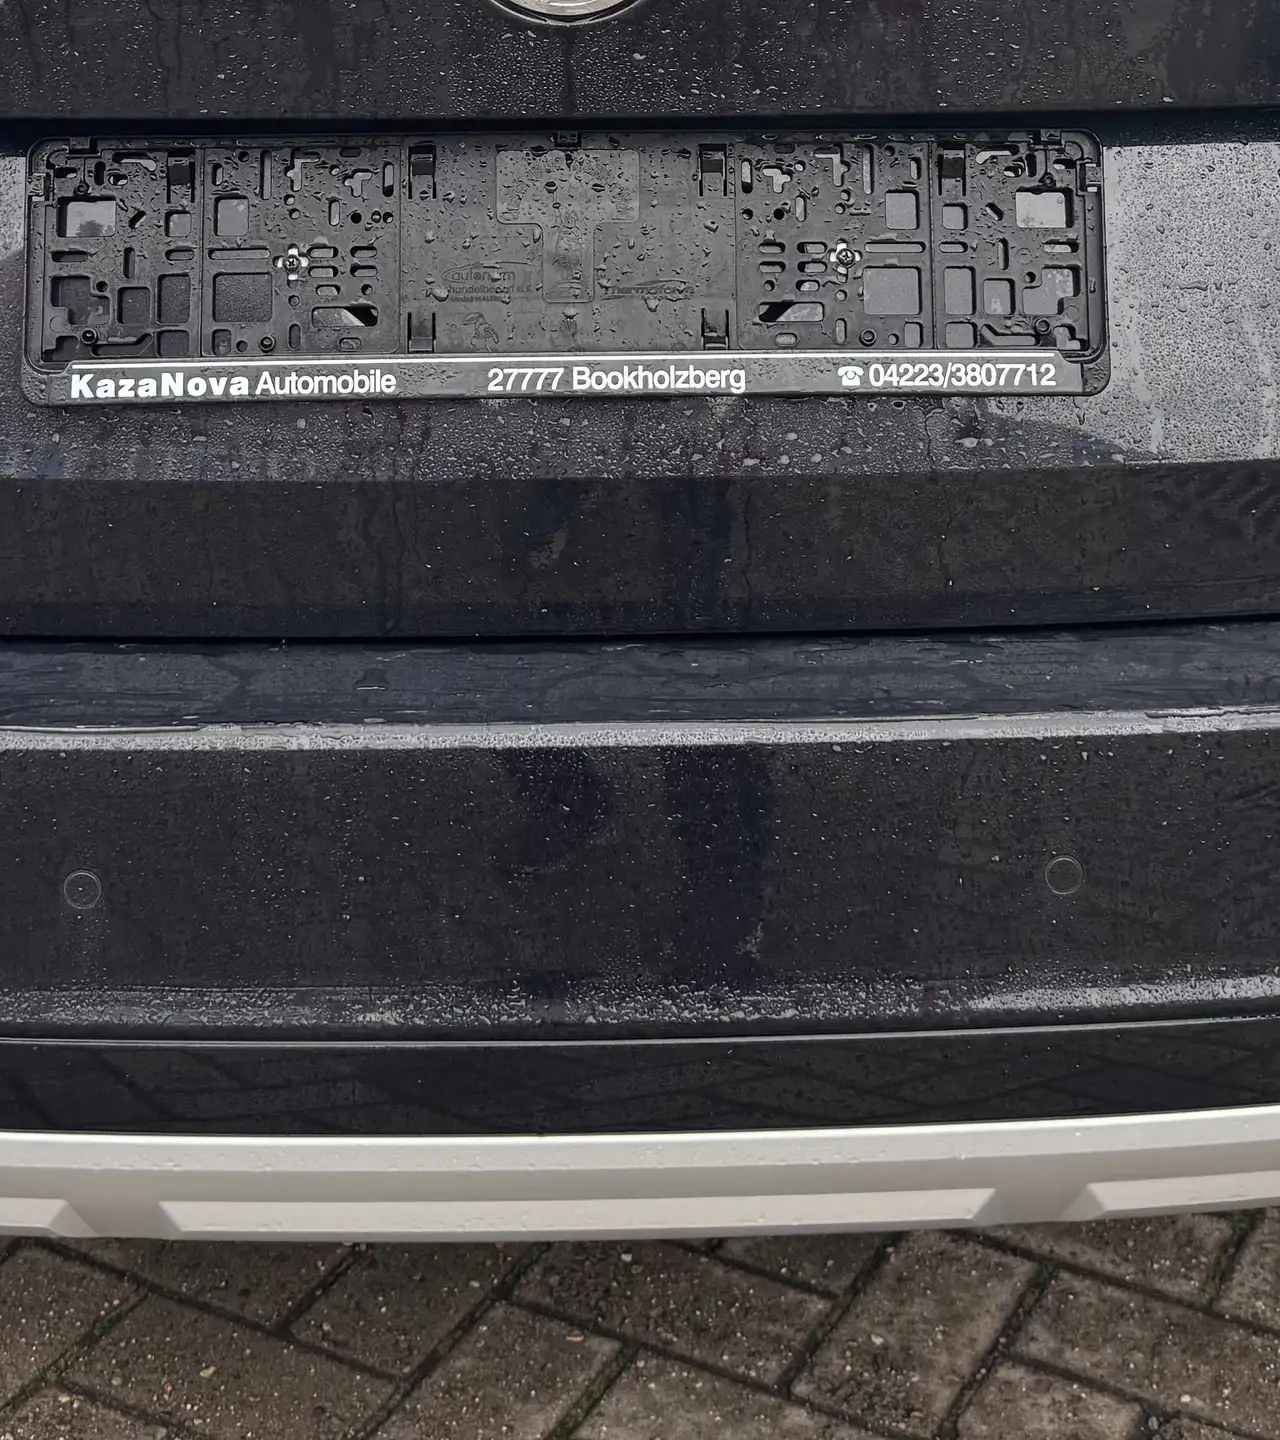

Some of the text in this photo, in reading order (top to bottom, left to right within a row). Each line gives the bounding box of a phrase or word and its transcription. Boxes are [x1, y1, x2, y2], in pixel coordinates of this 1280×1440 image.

[70, 361, 1057, 399] KazaNova Automobile 27777 Bookholzberg 04223/3807712
